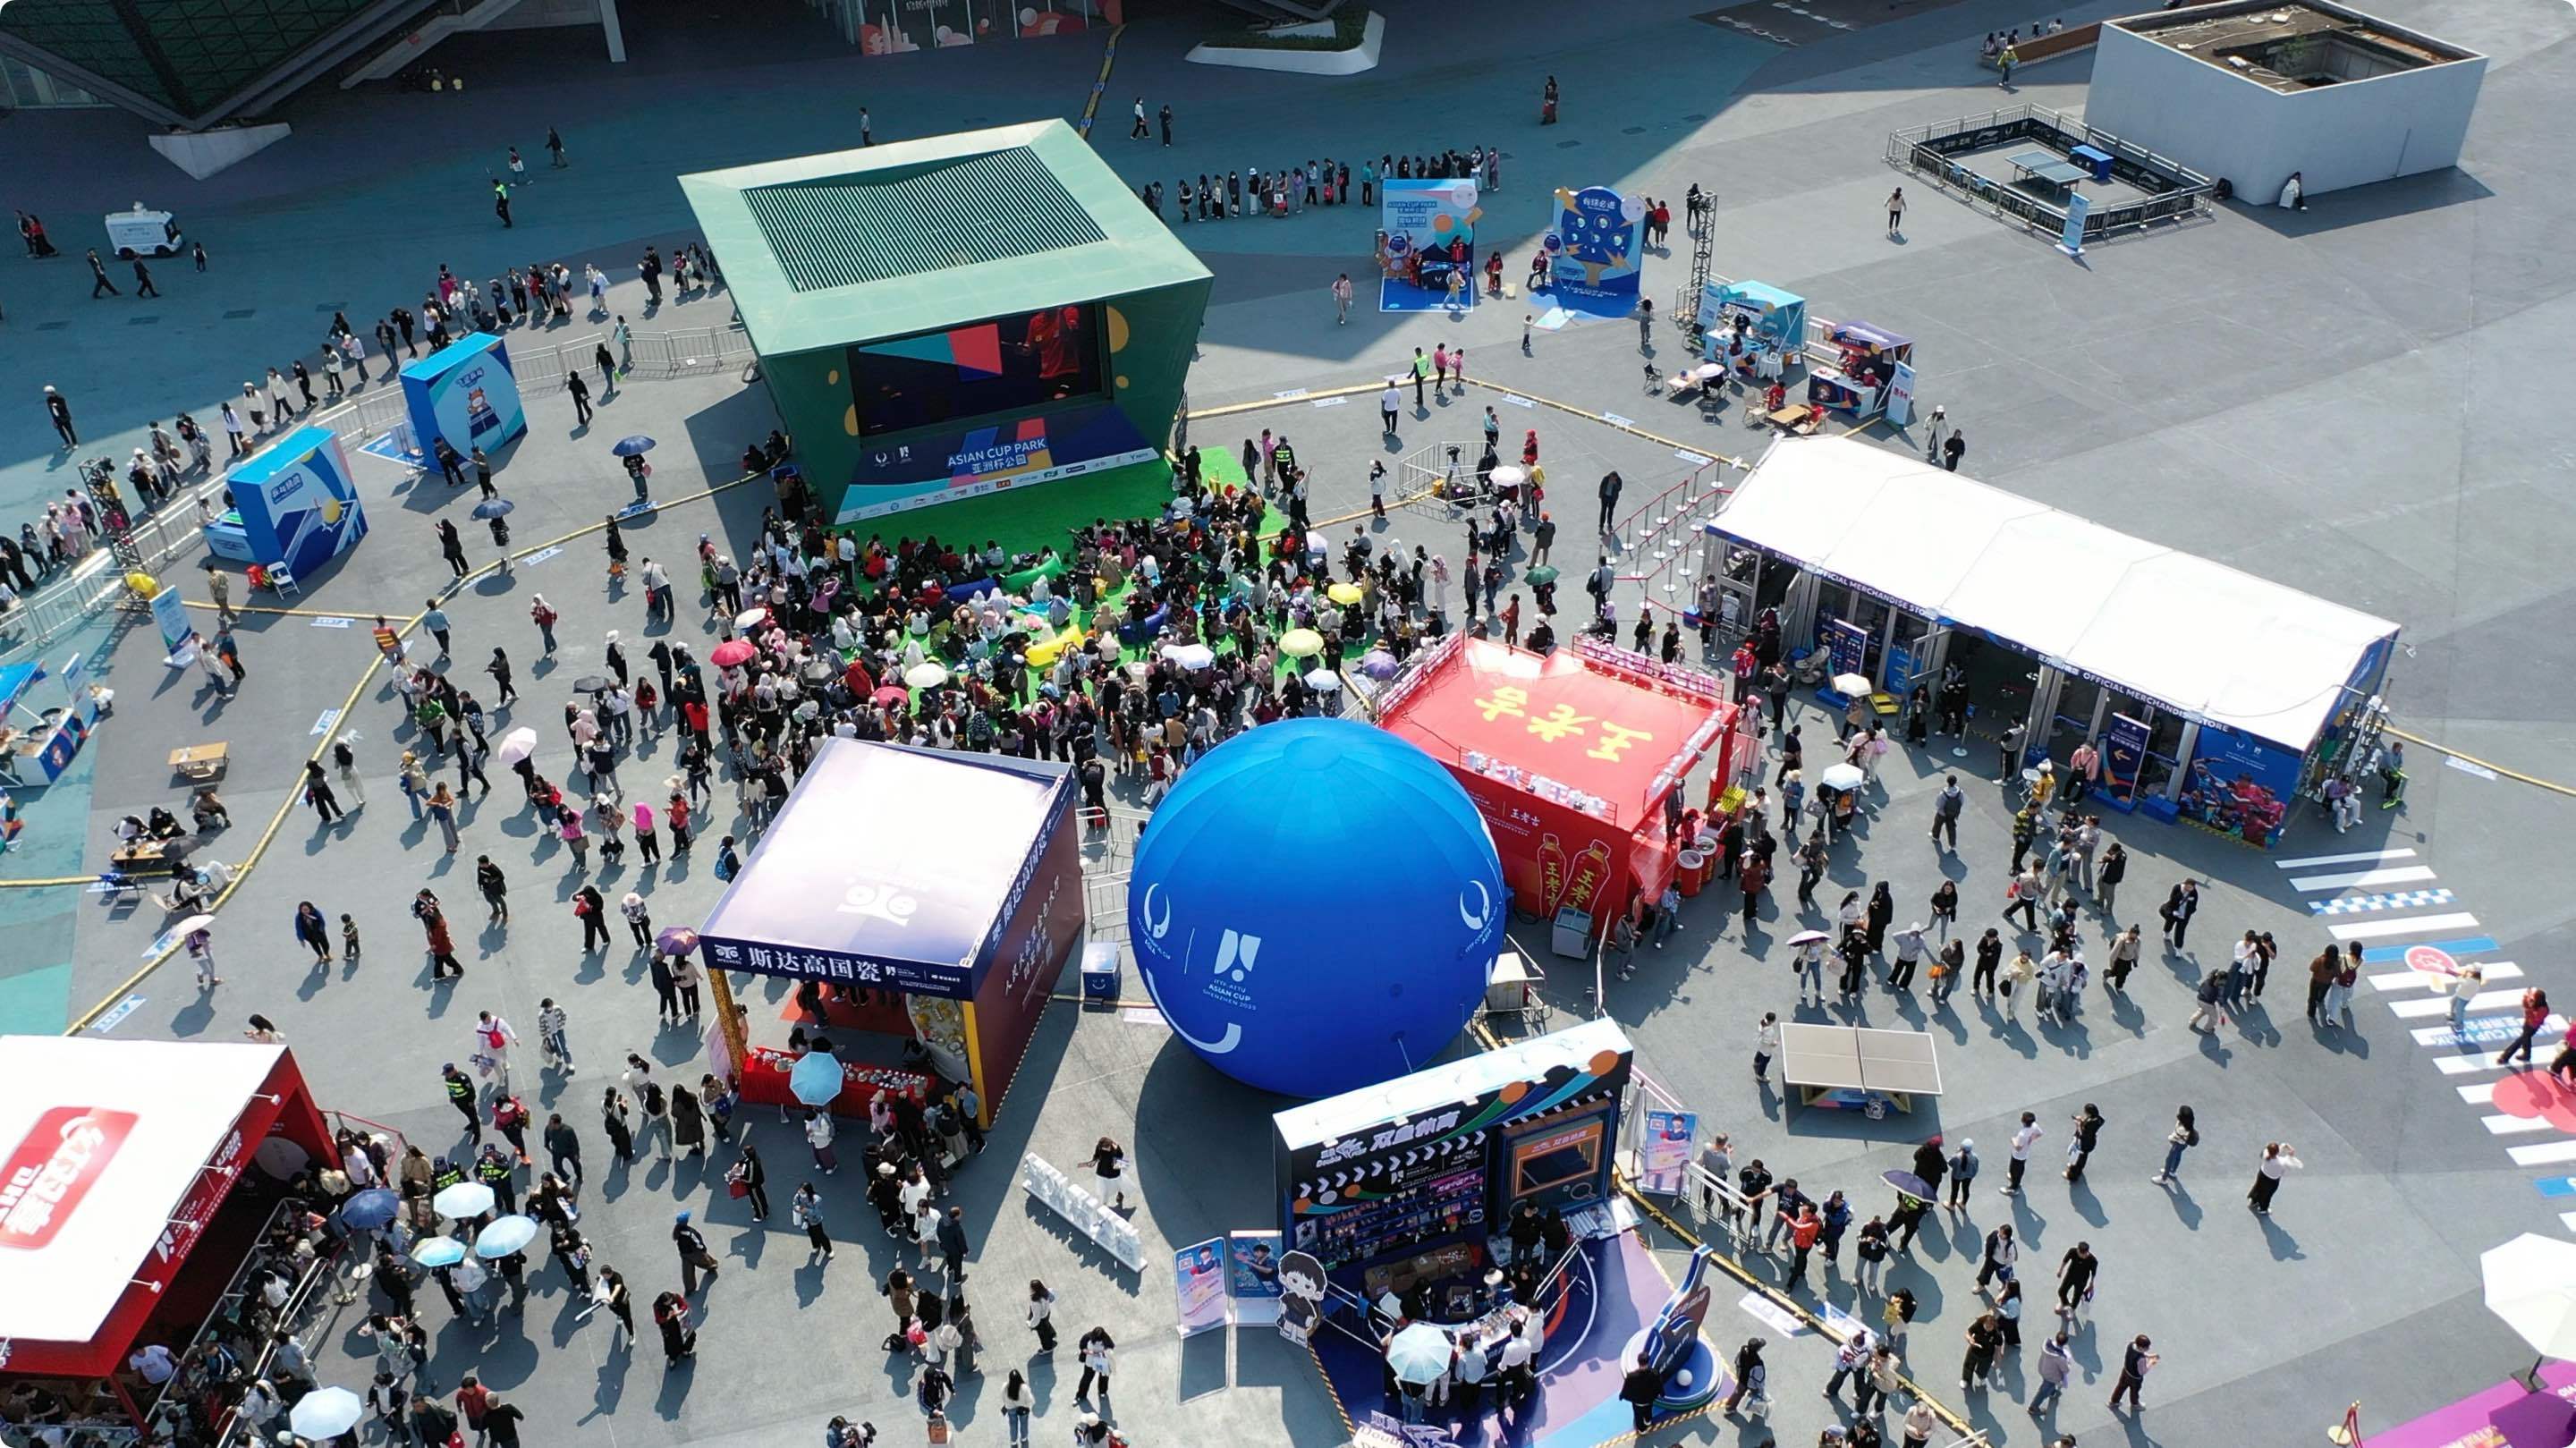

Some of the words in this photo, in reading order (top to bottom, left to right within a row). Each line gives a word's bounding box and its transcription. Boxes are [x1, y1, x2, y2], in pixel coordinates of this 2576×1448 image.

[948, 451, 984, 467] ASIAN
[987, 445, 1012, 459] CUP
[1014, 437, 1046, 453] PARK
[971, 453, 1027, 474] 亚洲杯公园
[1817, 568, 1849, 586] FFICIAL
[1849, 580, 1908, 610] MERCHANDISE
[1908, 605, 1927, 616] STO
[2082, 672, 2124, 694] OFFICIAL
[2126, 688, 2189, 719] MERCHANDIS
[1473, 685, 1653, 763] 王老吉
[1510, 807, 1541, 827] 王老吉
[748, 946, 882, 983] 斯达高国瓷
[1208, 983, 1233, 997] ASIAN
[1233, 992, 1251, 1002] CUP
